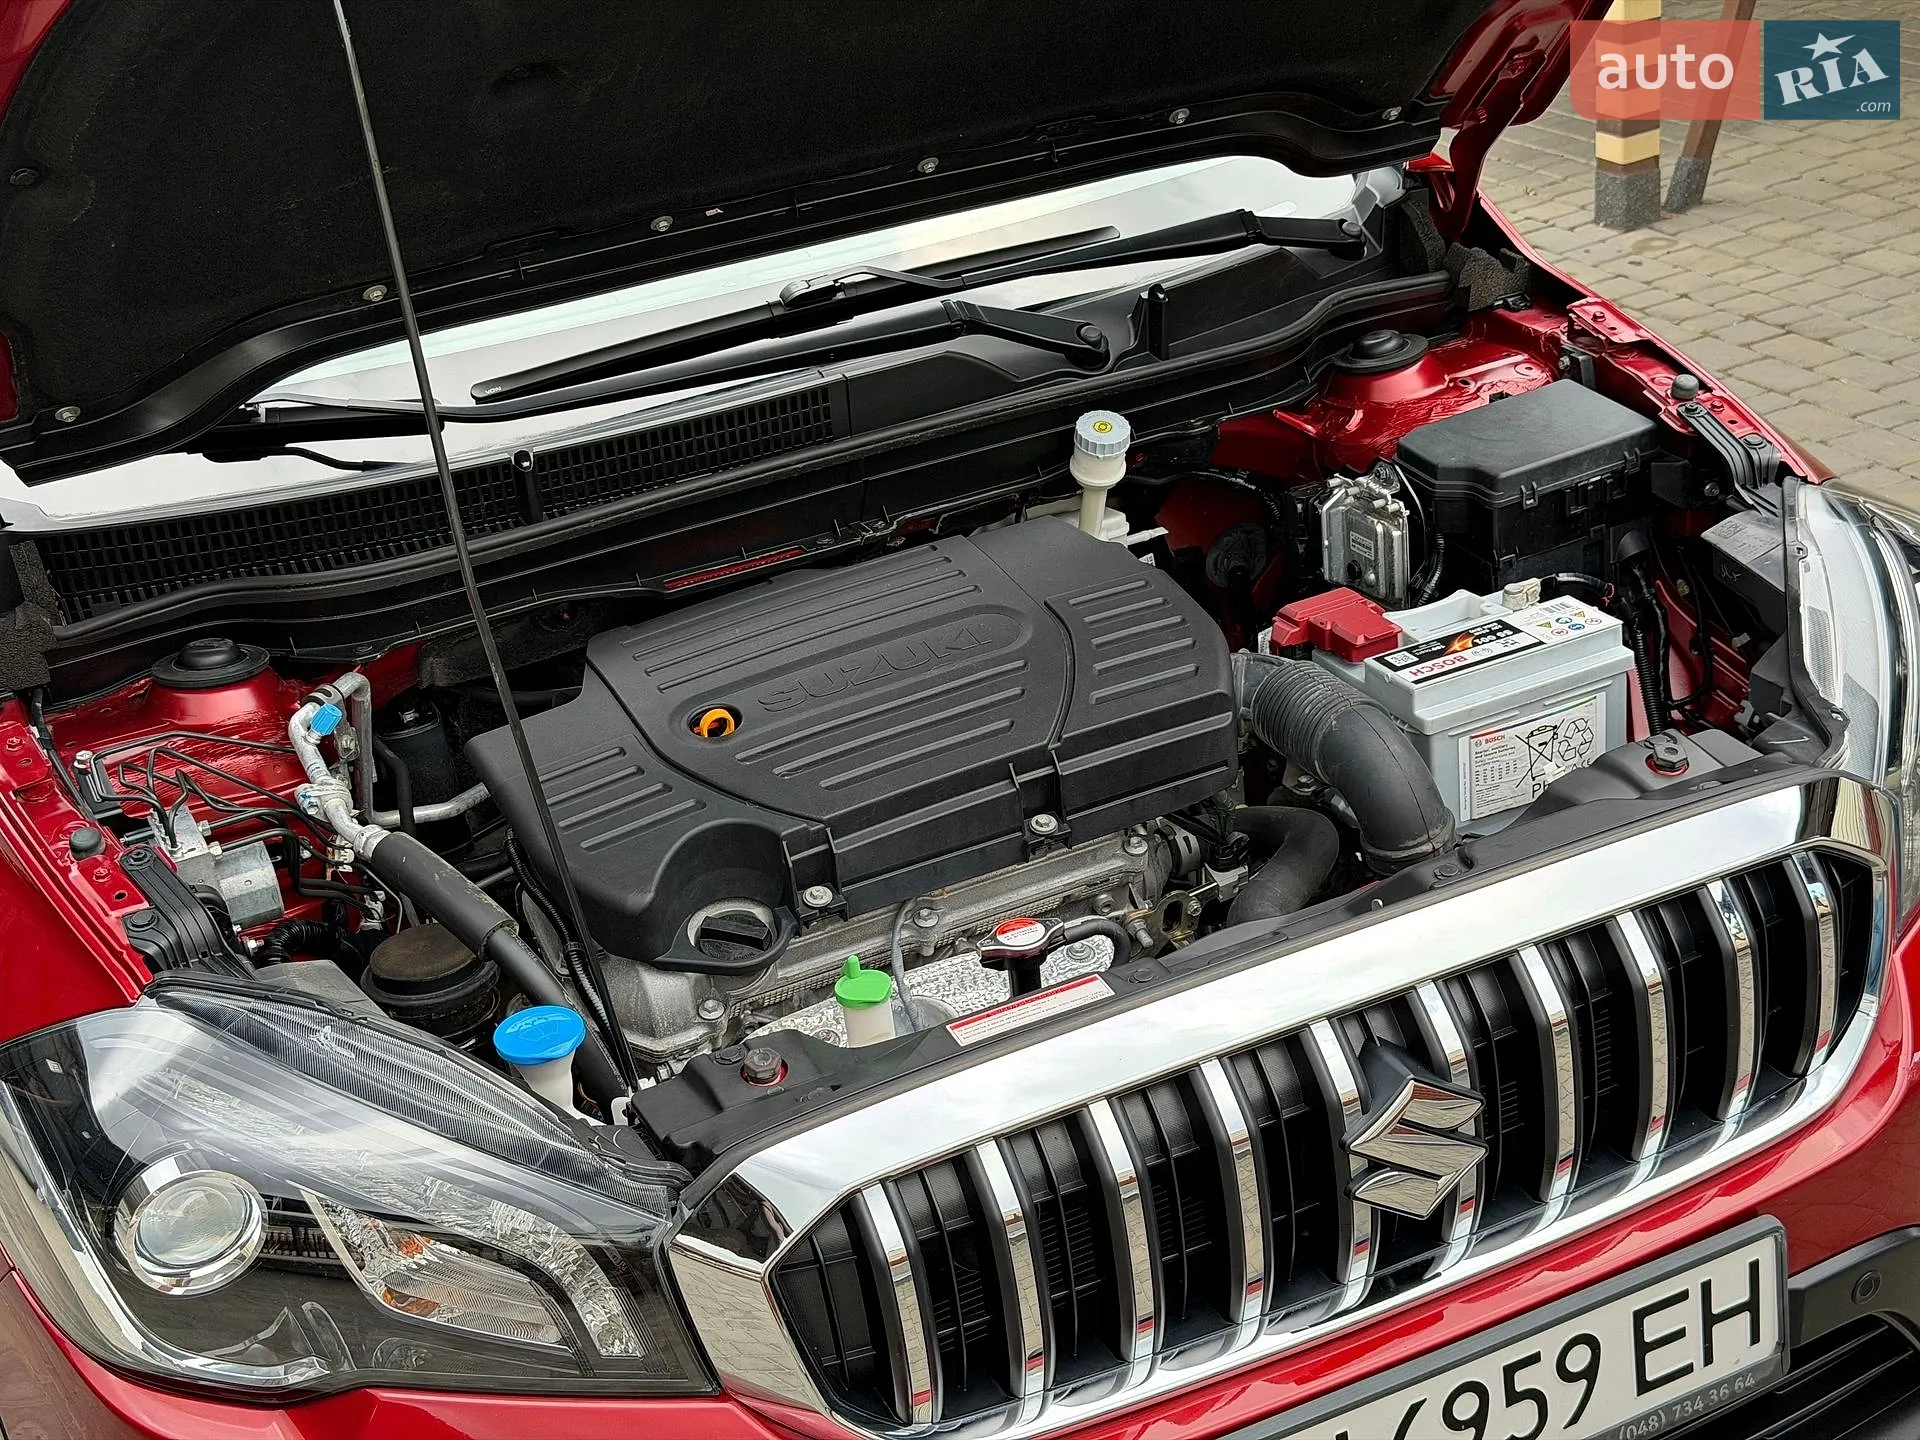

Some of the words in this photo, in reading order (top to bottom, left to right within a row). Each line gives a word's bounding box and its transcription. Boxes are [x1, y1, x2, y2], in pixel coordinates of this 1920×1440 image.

[757, 626, 993, 712] SUZUKI
[1409, 655, 1468, 677] BOSCH
[1484, 735, 1506, 744] BOSCH
[1634, 1258, 1761, 1397] EH
[1619, 1410, 1666, 1440] (048)
[1672, 1396, 1704, 1422] 734
[1708, 1383, 1730, 1406] 36
[1734, 1372, 1756, 1394] 64
